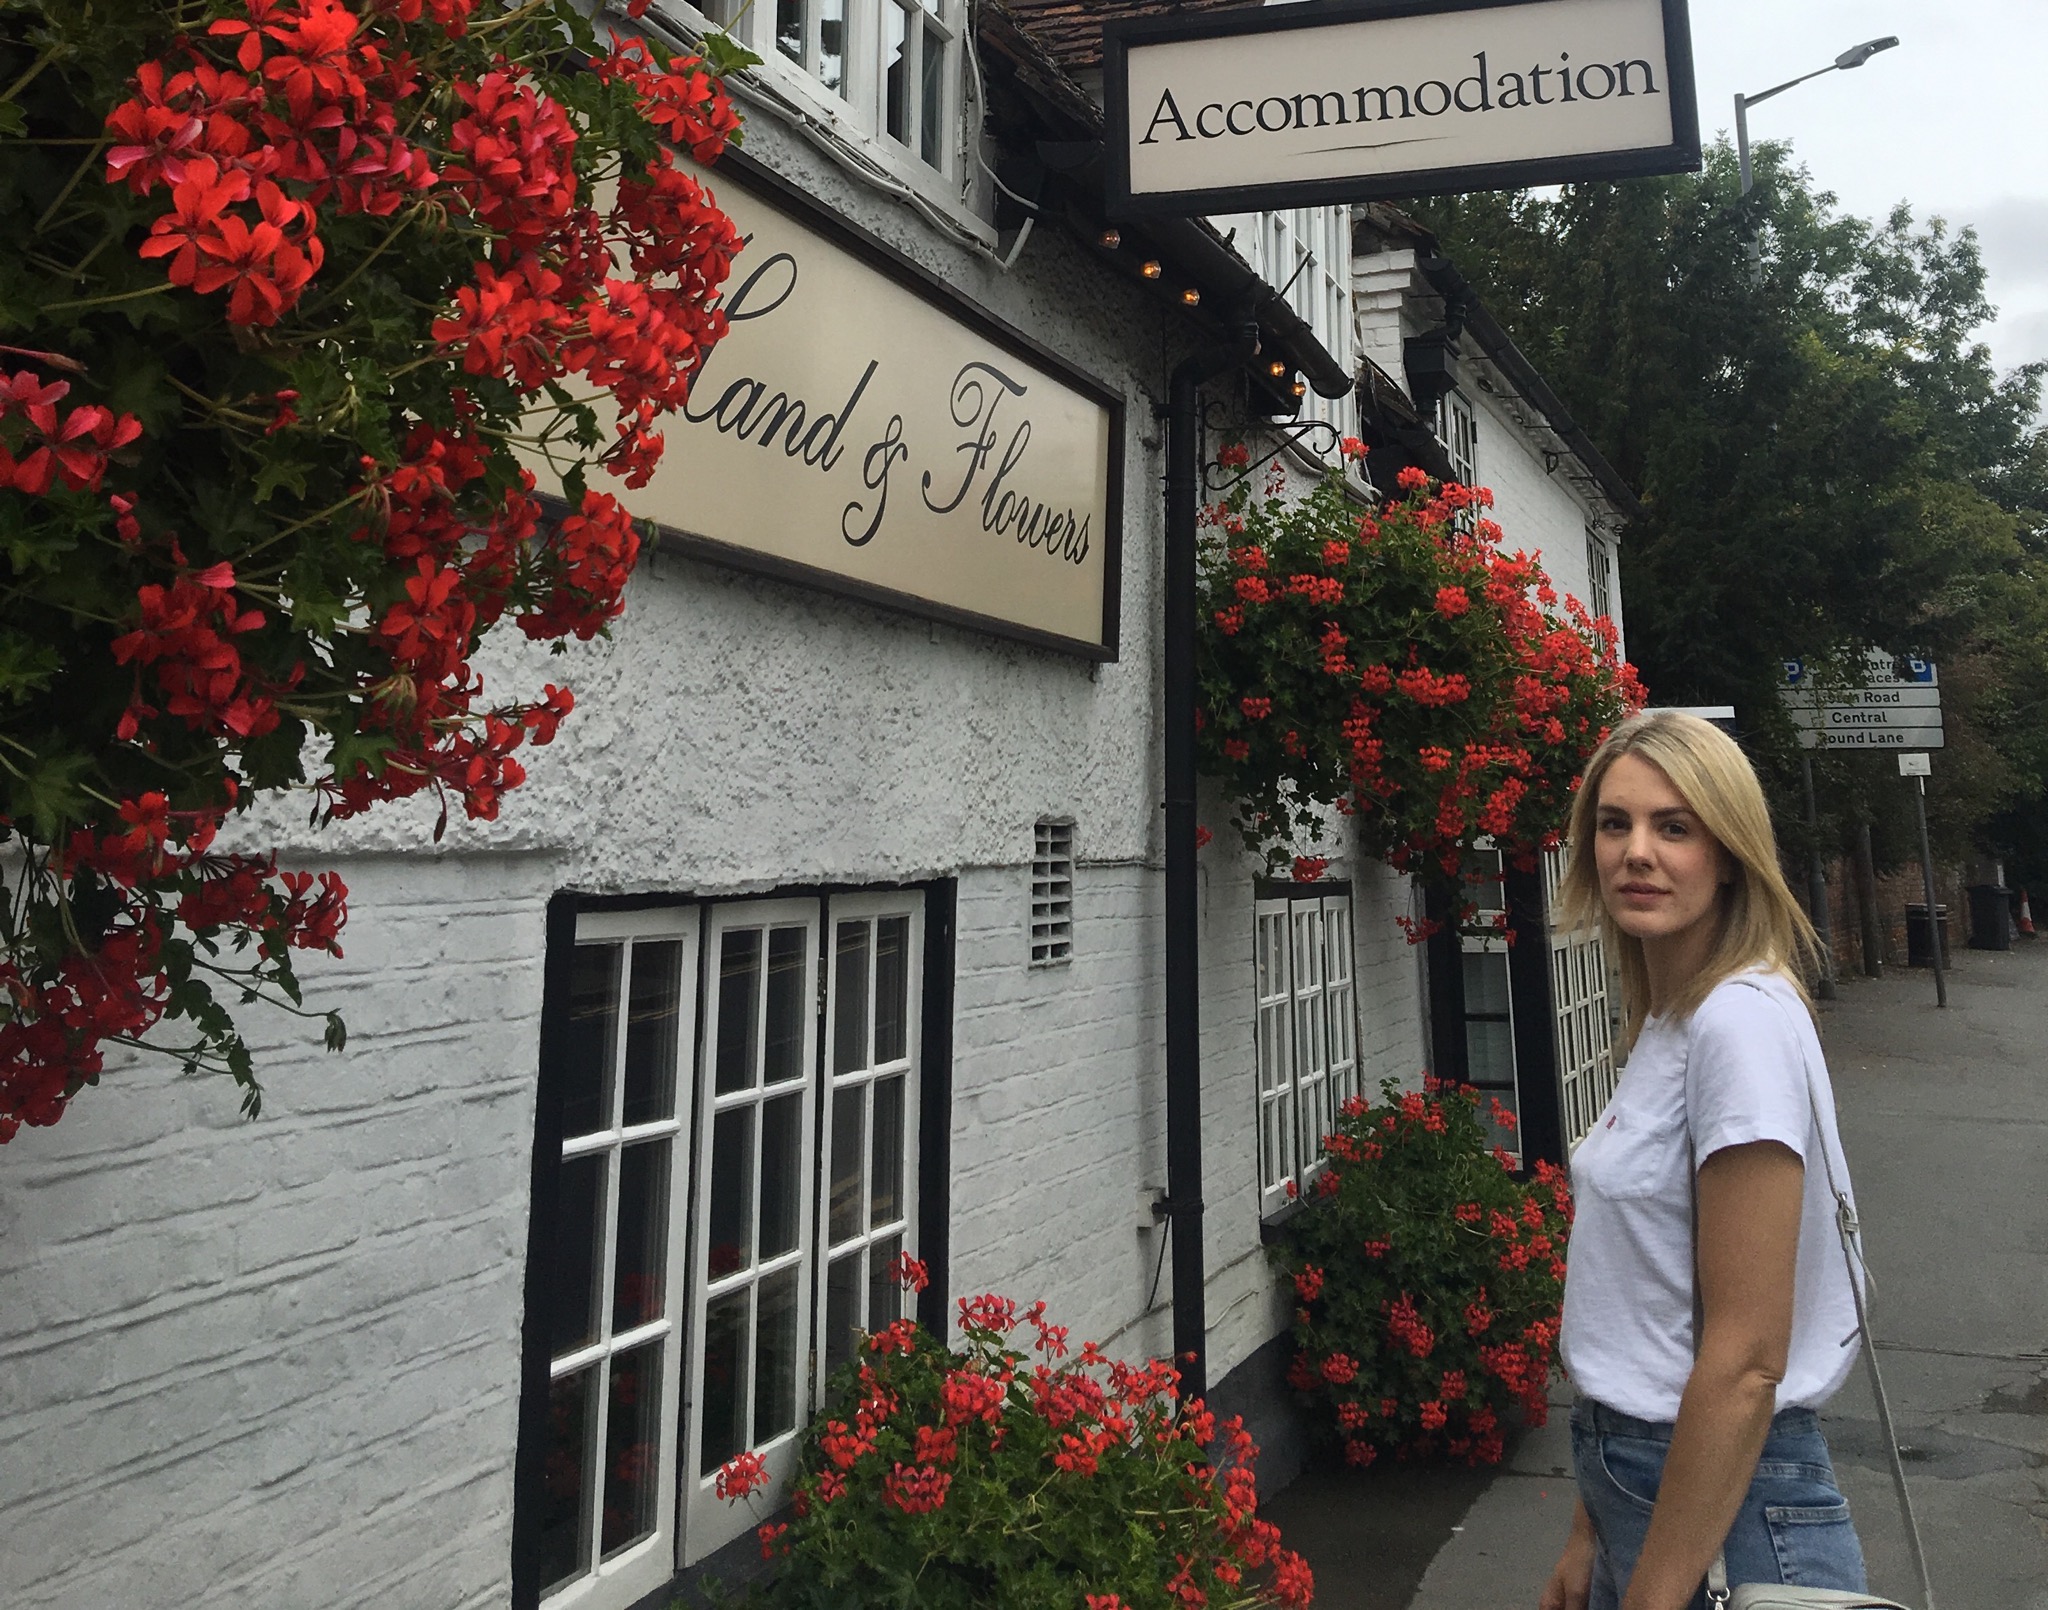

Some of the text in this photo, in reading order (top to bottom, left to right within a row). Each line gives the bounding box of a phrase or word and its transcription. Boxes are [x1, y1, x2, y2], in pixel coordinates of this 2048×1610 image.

[1138, 51, 1660, 145] Accommodation
[842, 414, 908, 547] &
[922, 361, 1091, 565] Flowers
[1864, 691, 1900, 703] Road
[1832, 712, 1887, 723] Central
[1868, 732, 1904, 743] Lane
